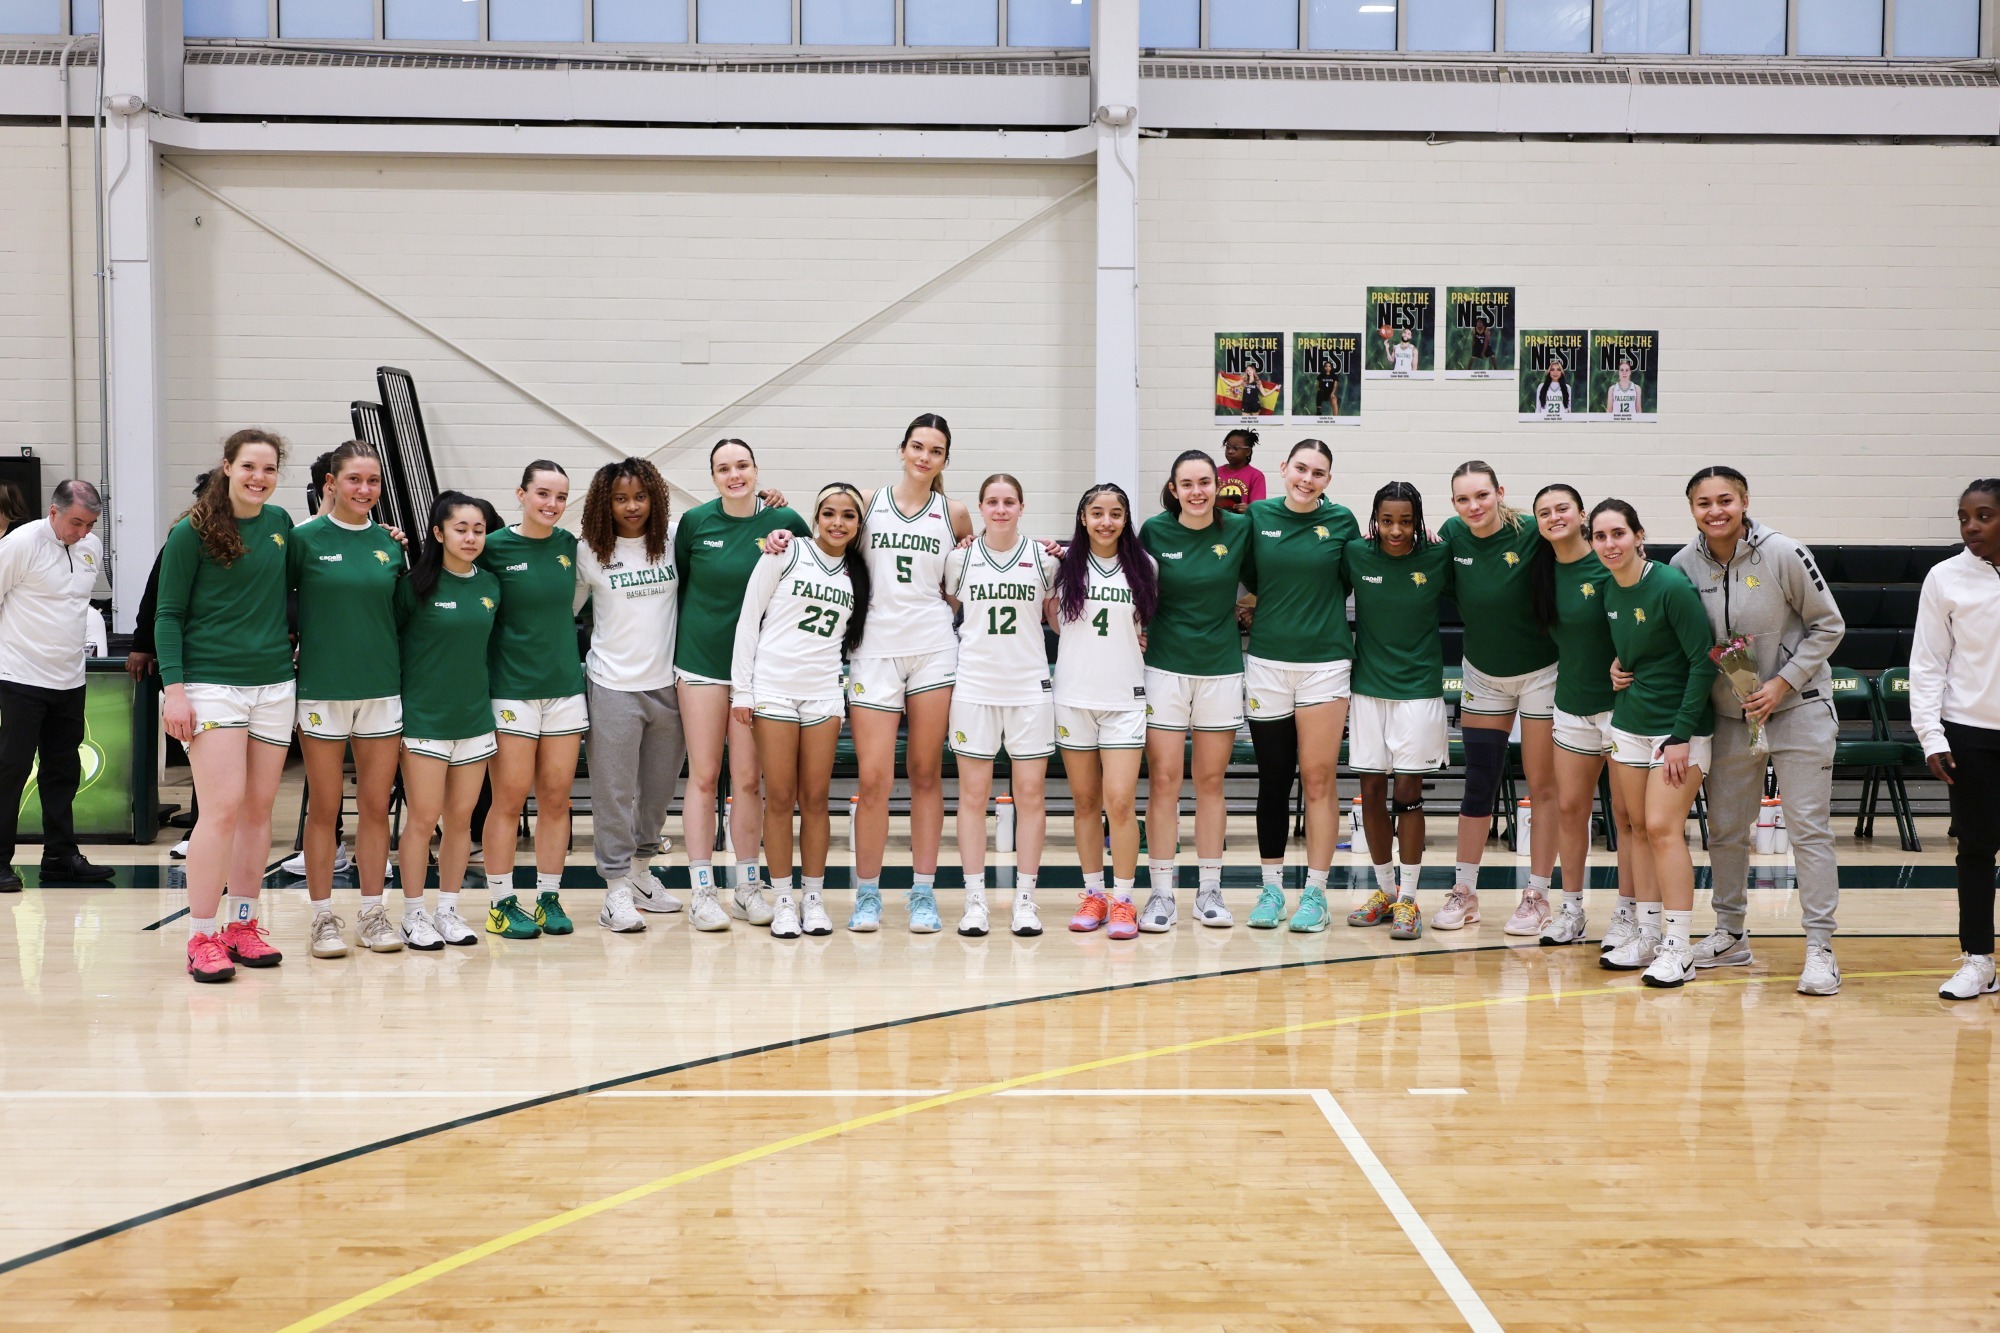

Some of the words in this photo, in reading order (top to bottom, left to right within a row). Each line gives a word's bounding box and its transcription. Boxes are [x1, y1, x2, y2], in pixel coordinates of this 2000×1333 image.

[1413, 292, 1429, 304] THE
[1493, 292, 1509, 304] THE
[1377, 302, 1427, 330] NEST
[1457, 301, 1506, 328] NEST
[1261, 338, 1278, 349] THE
[1340, 338, 1356, 349] THE
[1566, 335, 1582, 347] THE
[1637, 335, 1653, 347] THE
[1226, 346, 1275, 374] NEST
[1304, 346, 1353, 374] NEST
[1531, 343, 1579, 371] NEST
[1600, 343, 1650, 371] NEST
[1548, 403, 1560, 413] 23
[1620, 403, 1630, 412] 12
[871, 532, 940, 555] FALCONS
[609, 565, 676, 589] FELICIAN
[896, 555, 913, 583] 5
[626, 586, 666, 599] BASKETBALL
[792, 580, 855, 611] FALCONS
[969, 583, 1036, 601] FALCONS
[1083, 586, 1136, 605] ALCON
[798, 605, 840, 638] 23
[988, 606, 1017, 634] 12
[1092, 608, 1108, 636] 4
[1443, 680, 1463, 689] ICI
